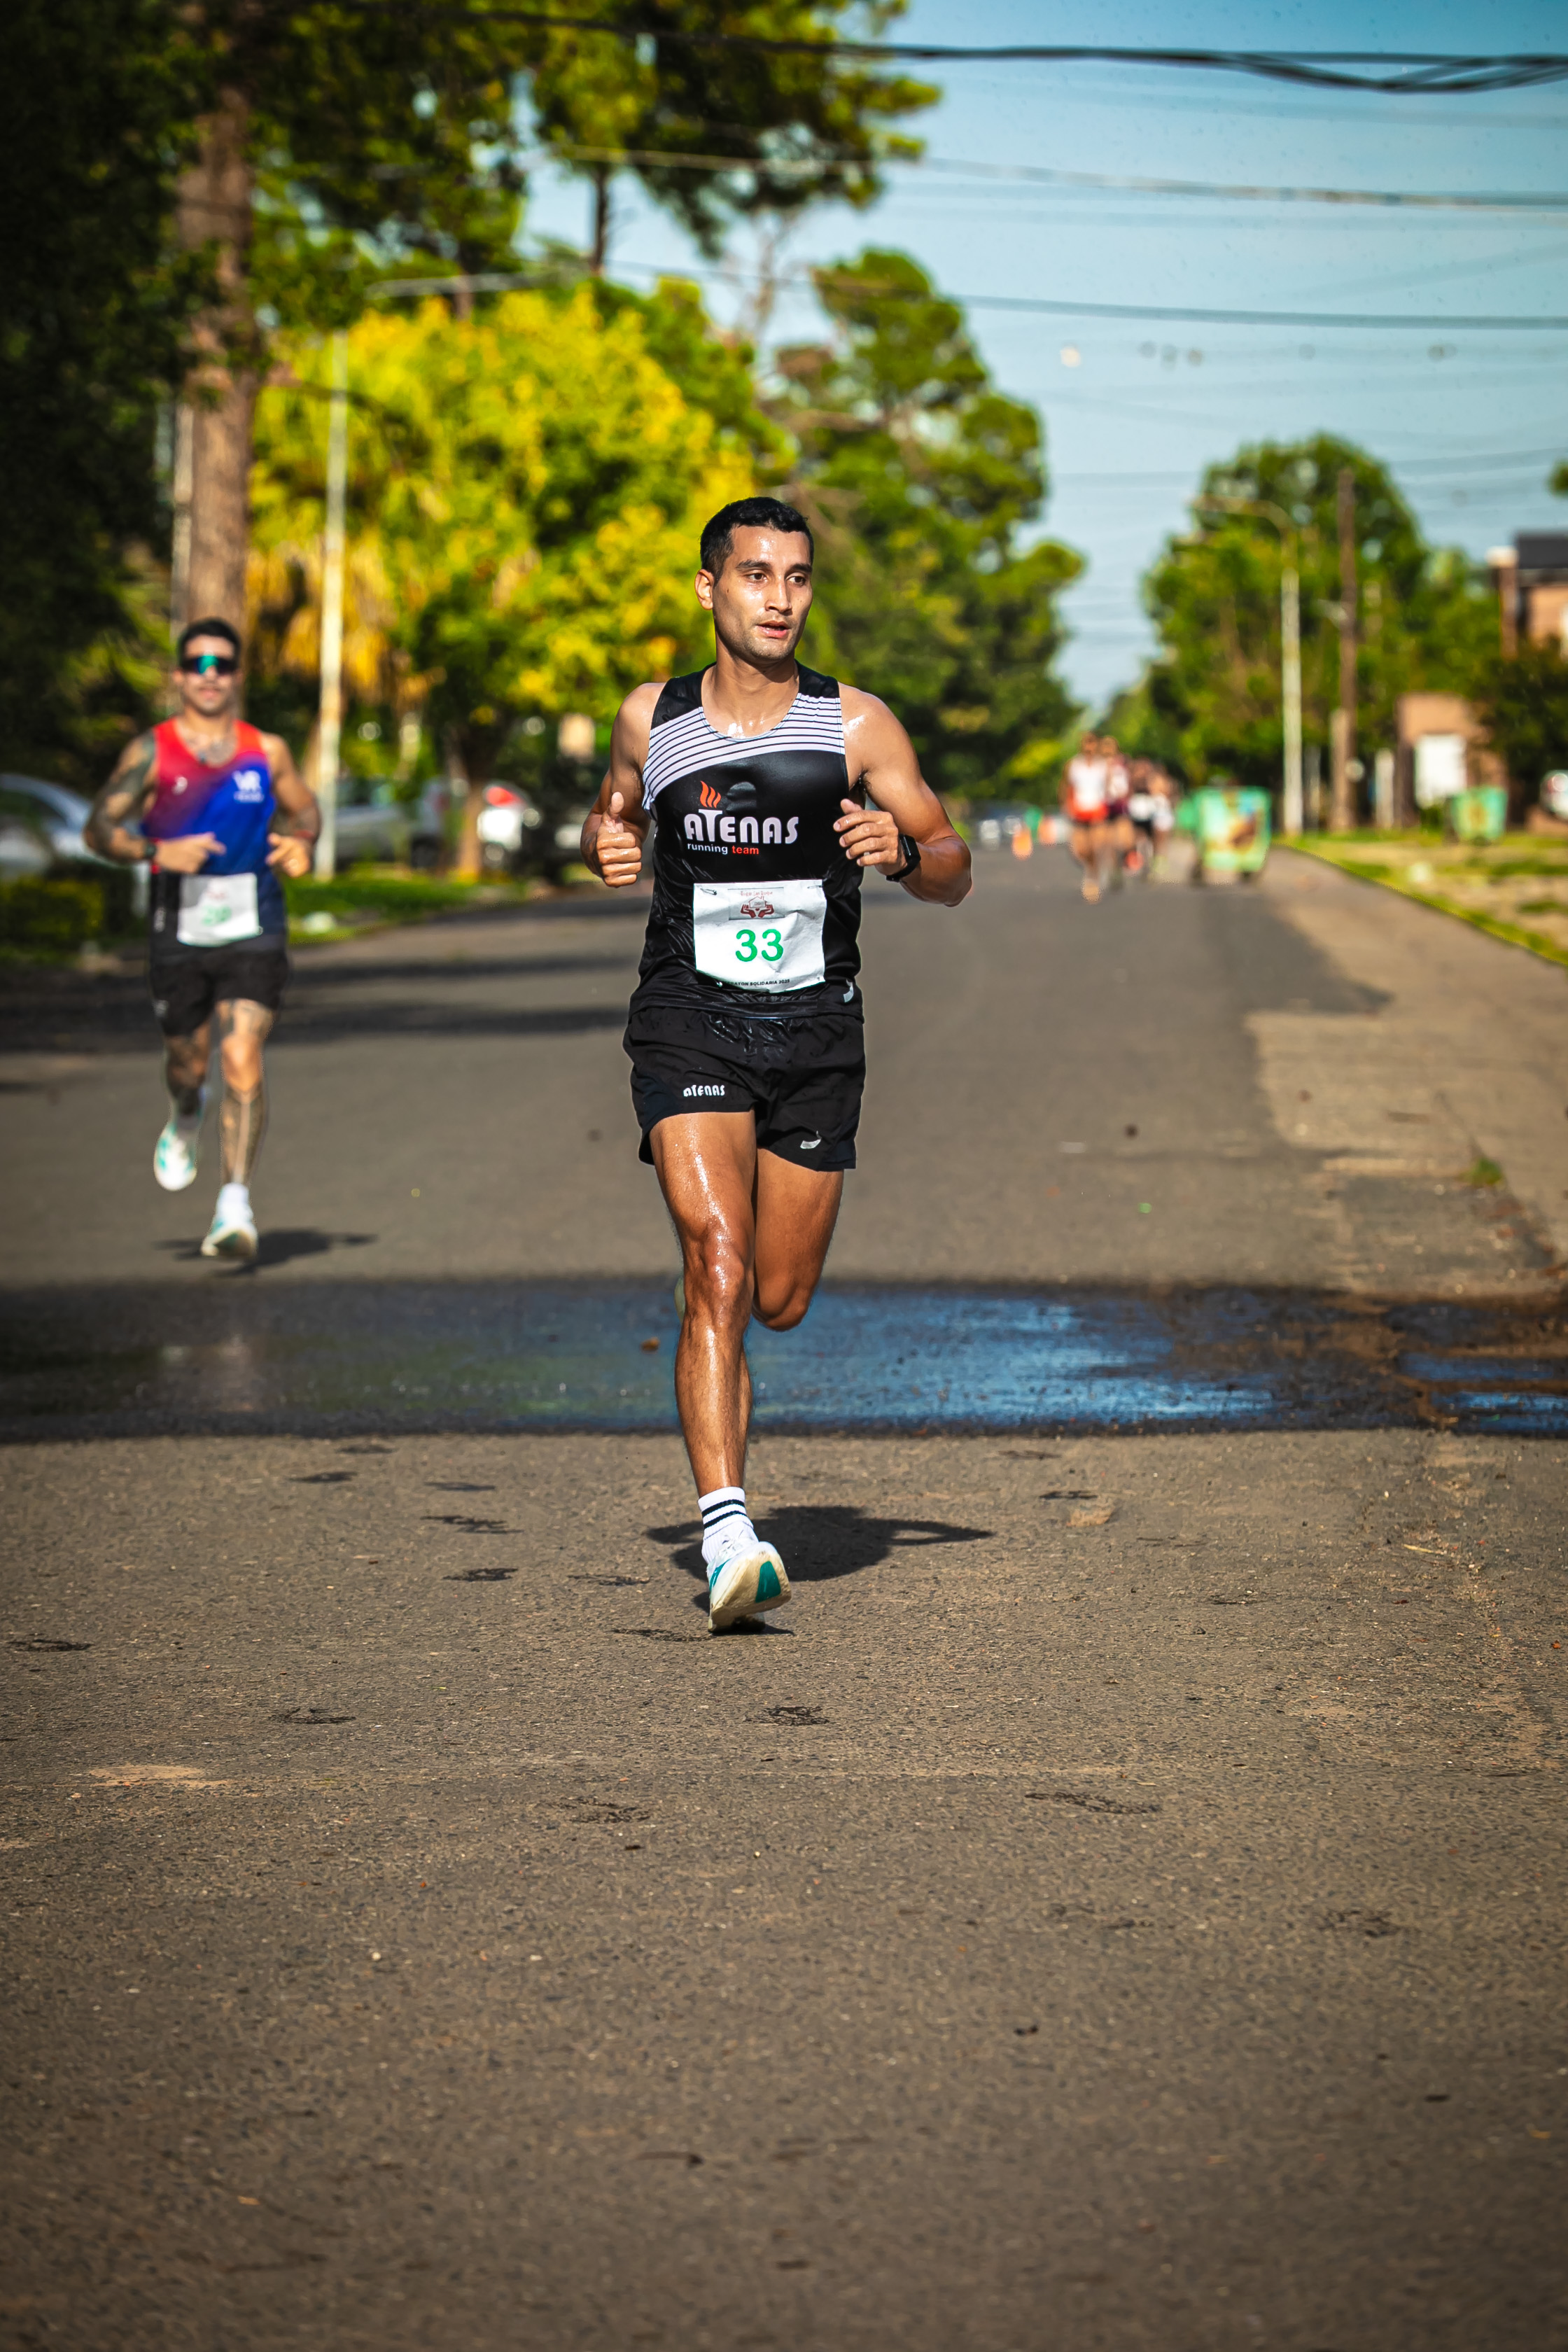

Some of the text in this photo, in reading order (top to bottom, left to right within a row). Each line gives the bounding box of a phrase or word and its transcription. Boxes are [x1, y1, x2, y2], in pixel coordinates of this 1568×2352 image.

[684, 808, 799, 844] ATENAS
[687, 843, 760, 855] running team
[735, 929, 784, 962] 33
